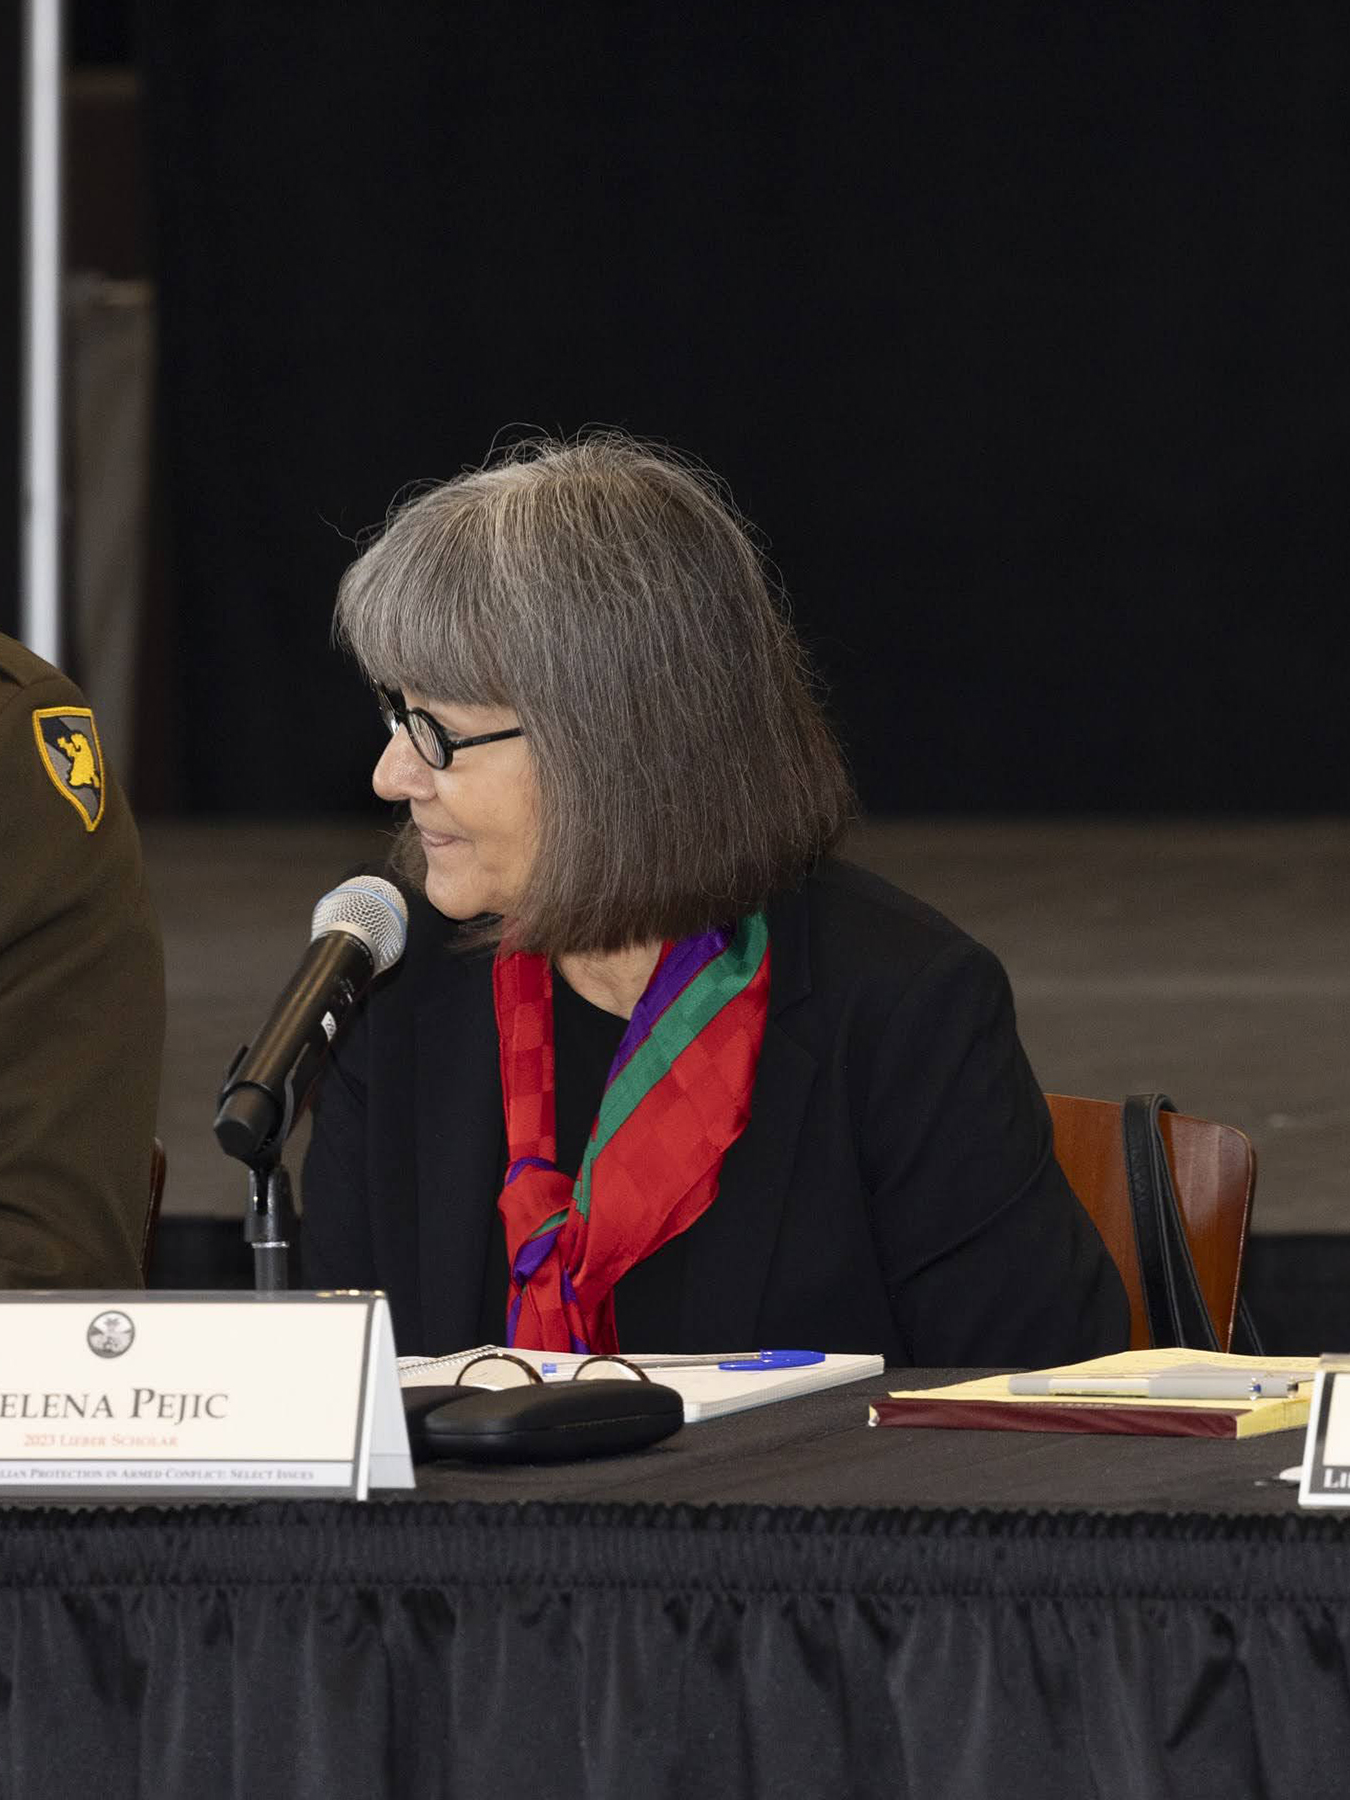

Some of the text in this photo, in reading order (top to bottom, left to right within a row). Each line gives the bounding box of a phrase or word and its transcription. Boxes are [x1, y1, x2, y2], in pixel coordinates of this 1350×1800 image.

[129, 1387, 229, 1426] PEJIC
[23, 1433, 179, 1448] 2023 LIEBER SCHOLAR
[30, 1467, 102, 1480] PROTECTION
[105, 1469, 118, 1480] IN
[121, 1468, 162, 1480] ARMED
[229, 1468, 273, 1480] SELECT
[275, 1468, 315, 1481] ISSUES
[1324, 1468, 1350, 1489] LI
